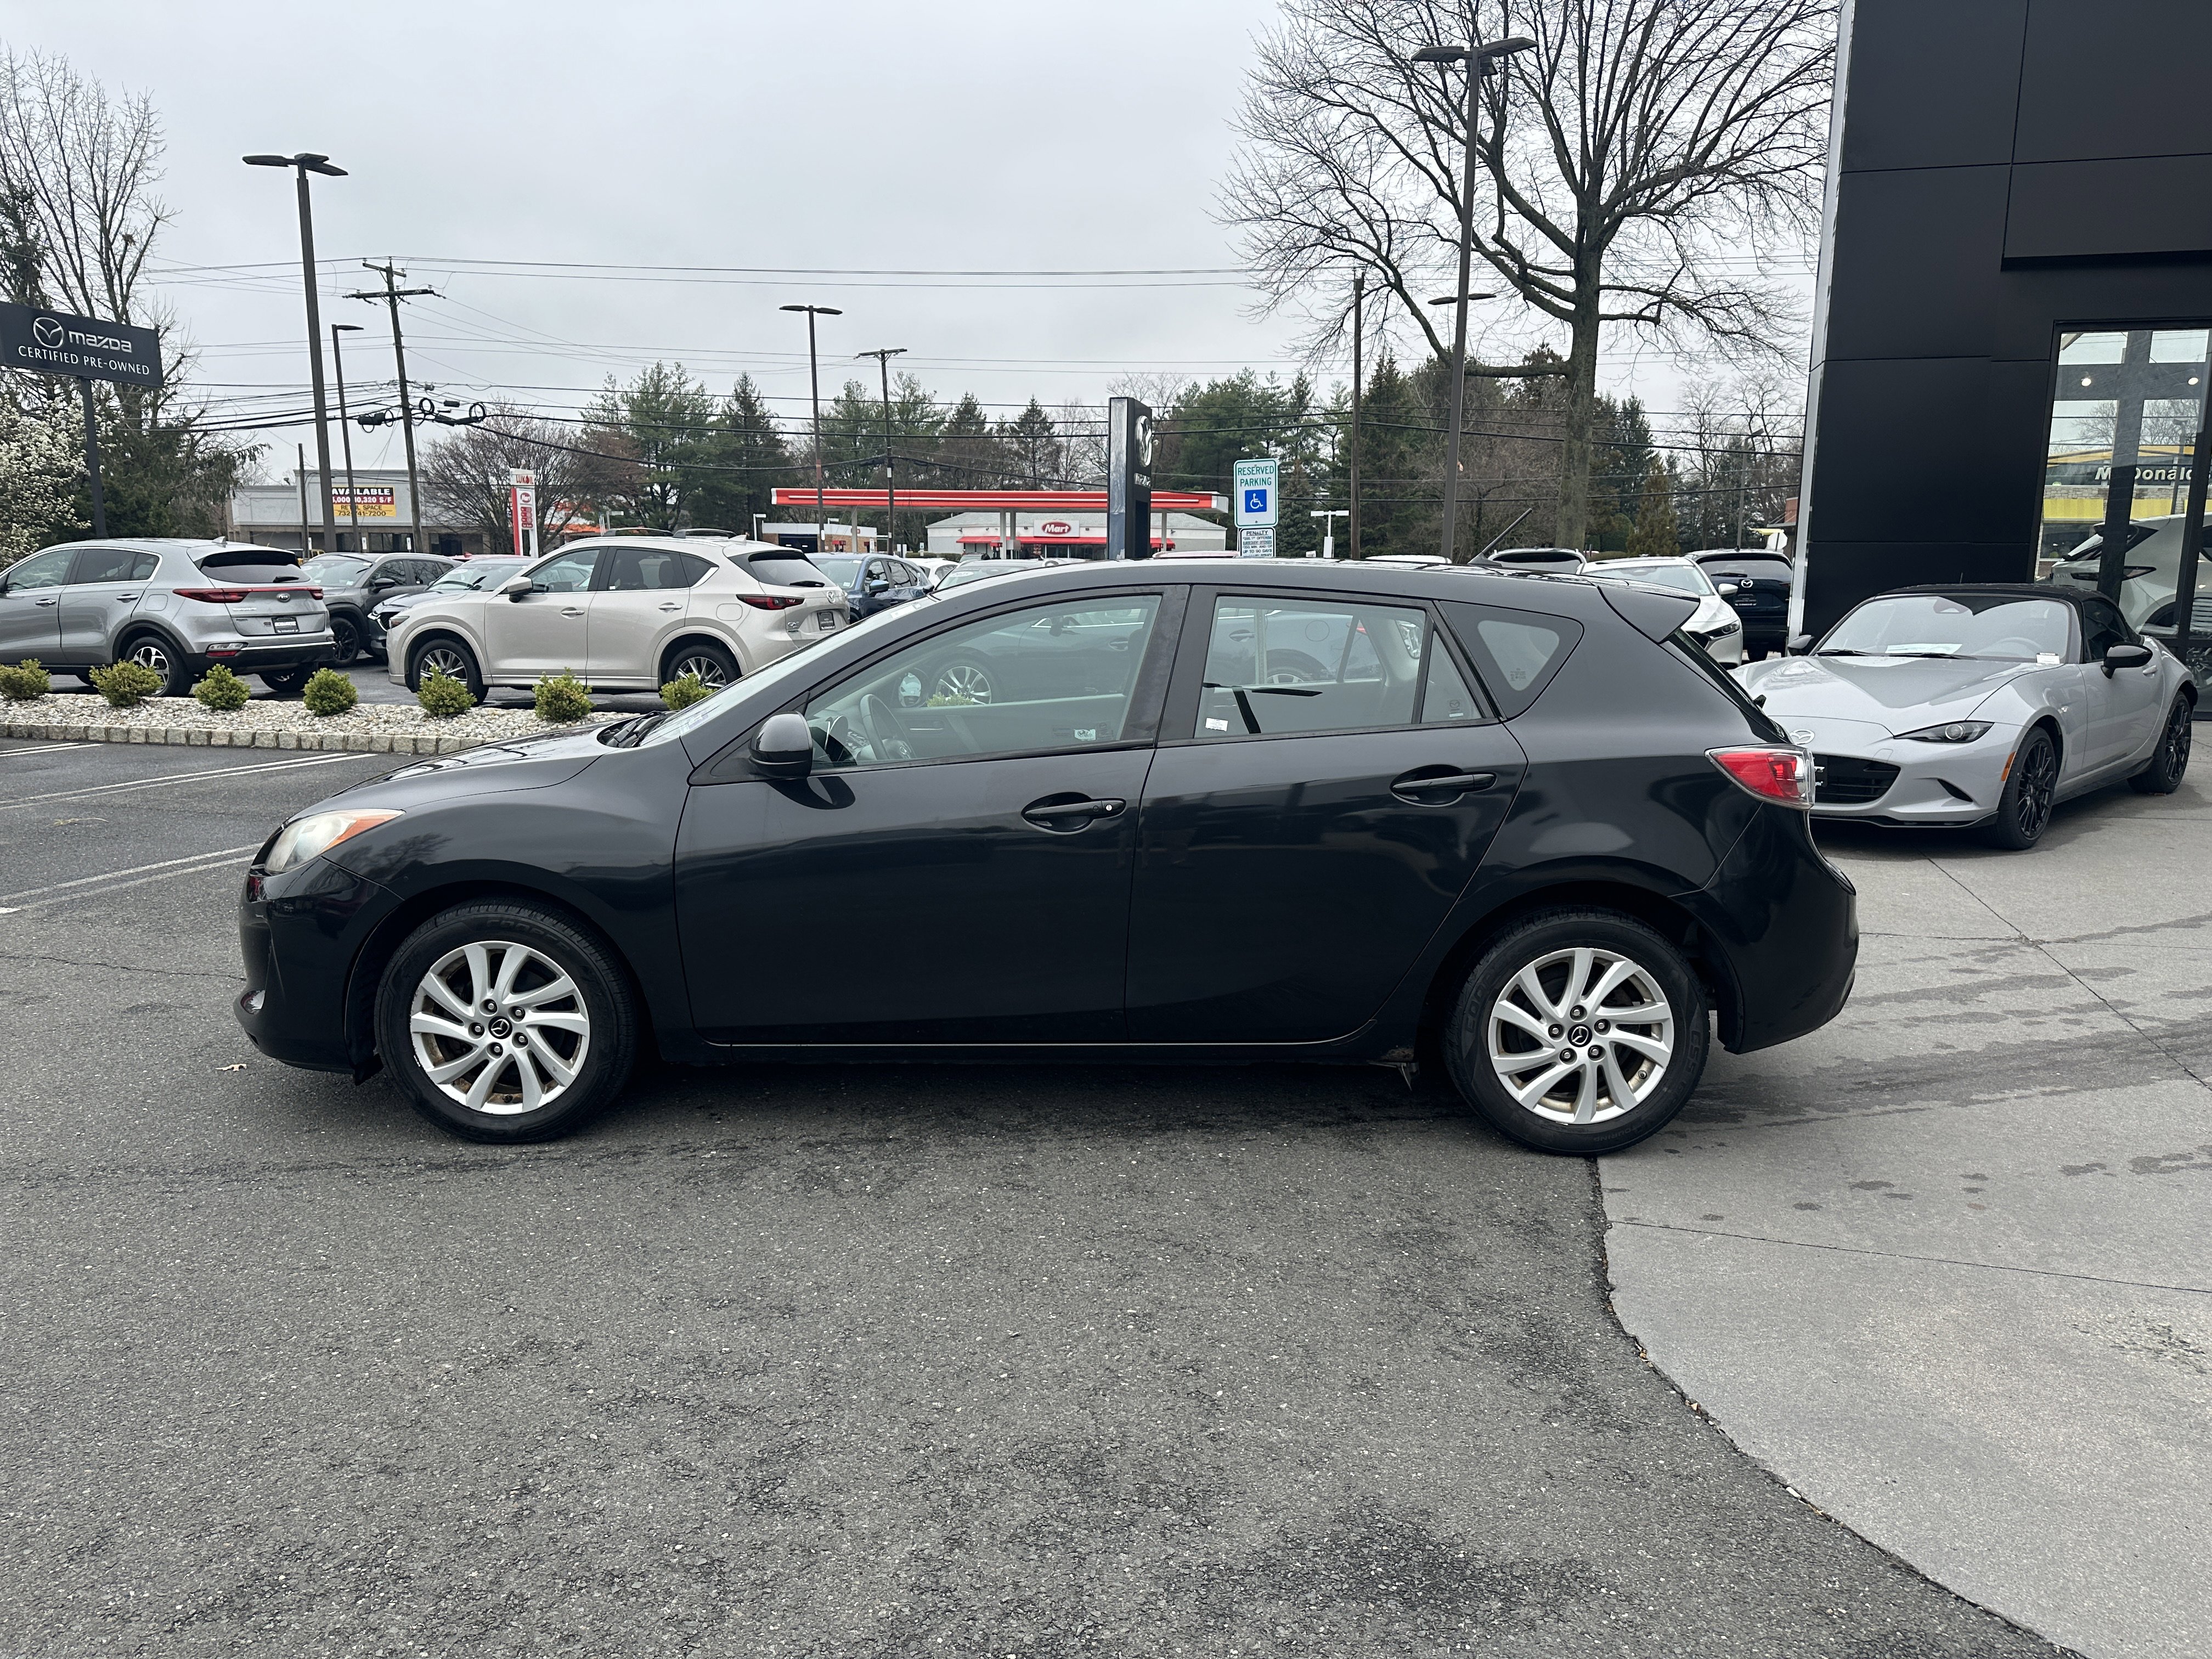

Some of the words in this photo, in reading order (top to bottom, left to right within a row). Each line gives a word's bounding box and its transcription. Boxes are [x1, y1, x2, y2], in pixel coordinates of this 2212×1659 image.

[69, 330, 132, 353] mazda
[18, 346, 78, 364] CERTIFIED
[83, 356, 149, 375] PRE-OWNED
[1238, 466, 1274, 476] RESERVED
[516, 474, 534, 484] LUKOIL
[1240, 477, 1272, 487] PARKING
[1044, 524, 1069, 533] Mart
